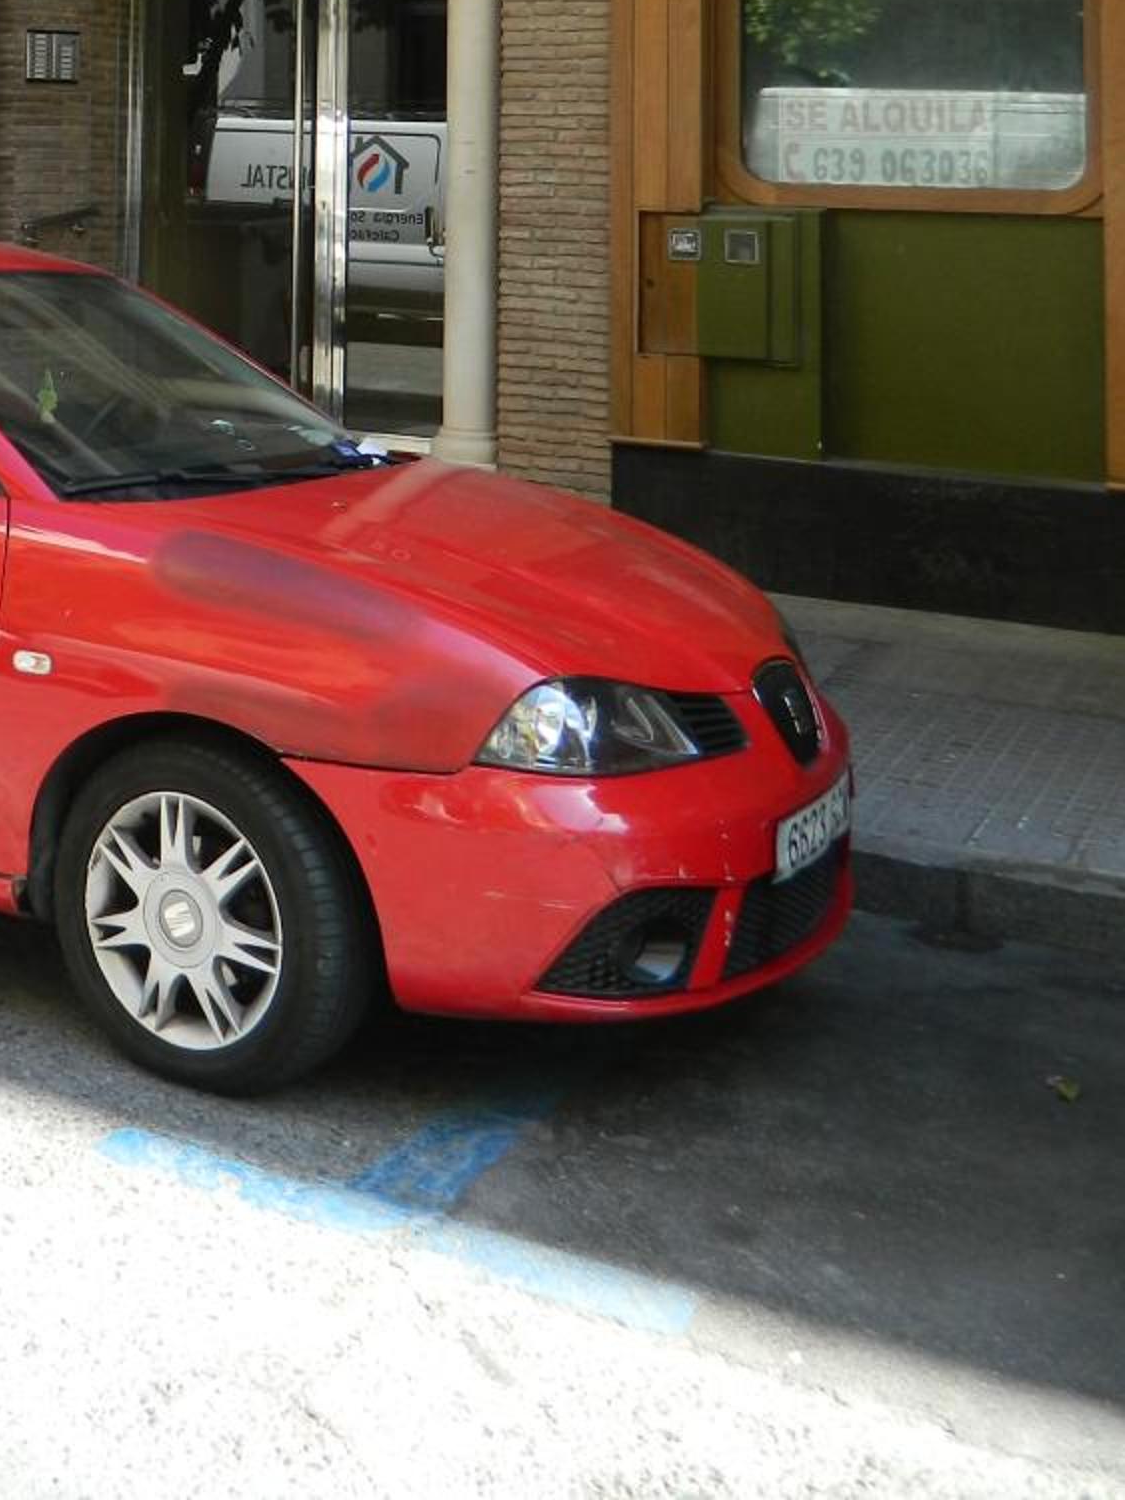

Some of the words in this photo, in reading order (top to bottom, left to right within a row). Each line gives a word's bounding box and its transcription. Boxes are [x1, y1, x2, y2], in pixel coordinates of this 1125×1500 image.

[785, 100, 827, 131] SE
[839, 99, 987, 133] ALQUILA
[813, 148, 866, 181] 639
